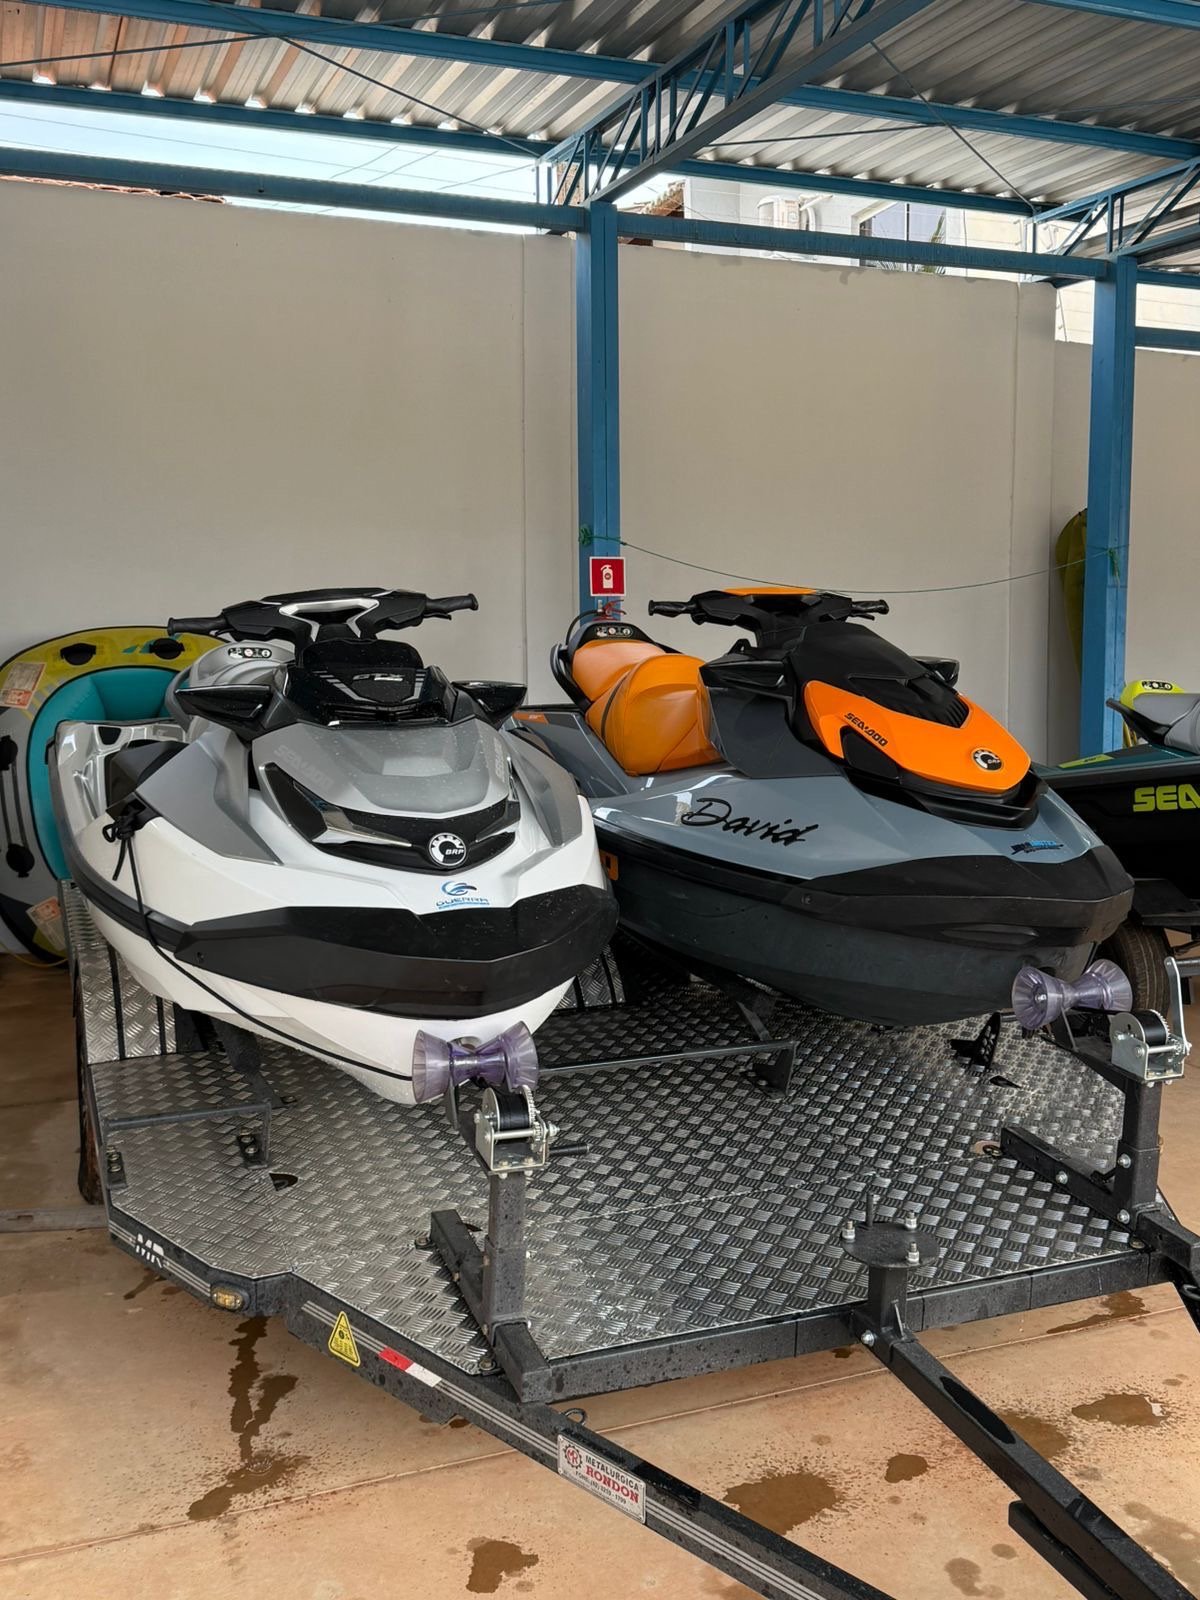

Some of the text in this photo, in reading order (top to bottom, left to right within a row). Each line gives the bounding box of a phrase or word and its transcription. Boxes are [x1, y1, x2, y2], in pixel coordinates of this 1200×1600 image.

[681, 797, 819, 847] David
[445, 848, 465, 856] BRP
[585, 1454, 639, 1492] METALURGICA
[585, 1464, 639, 1504] RONDON
